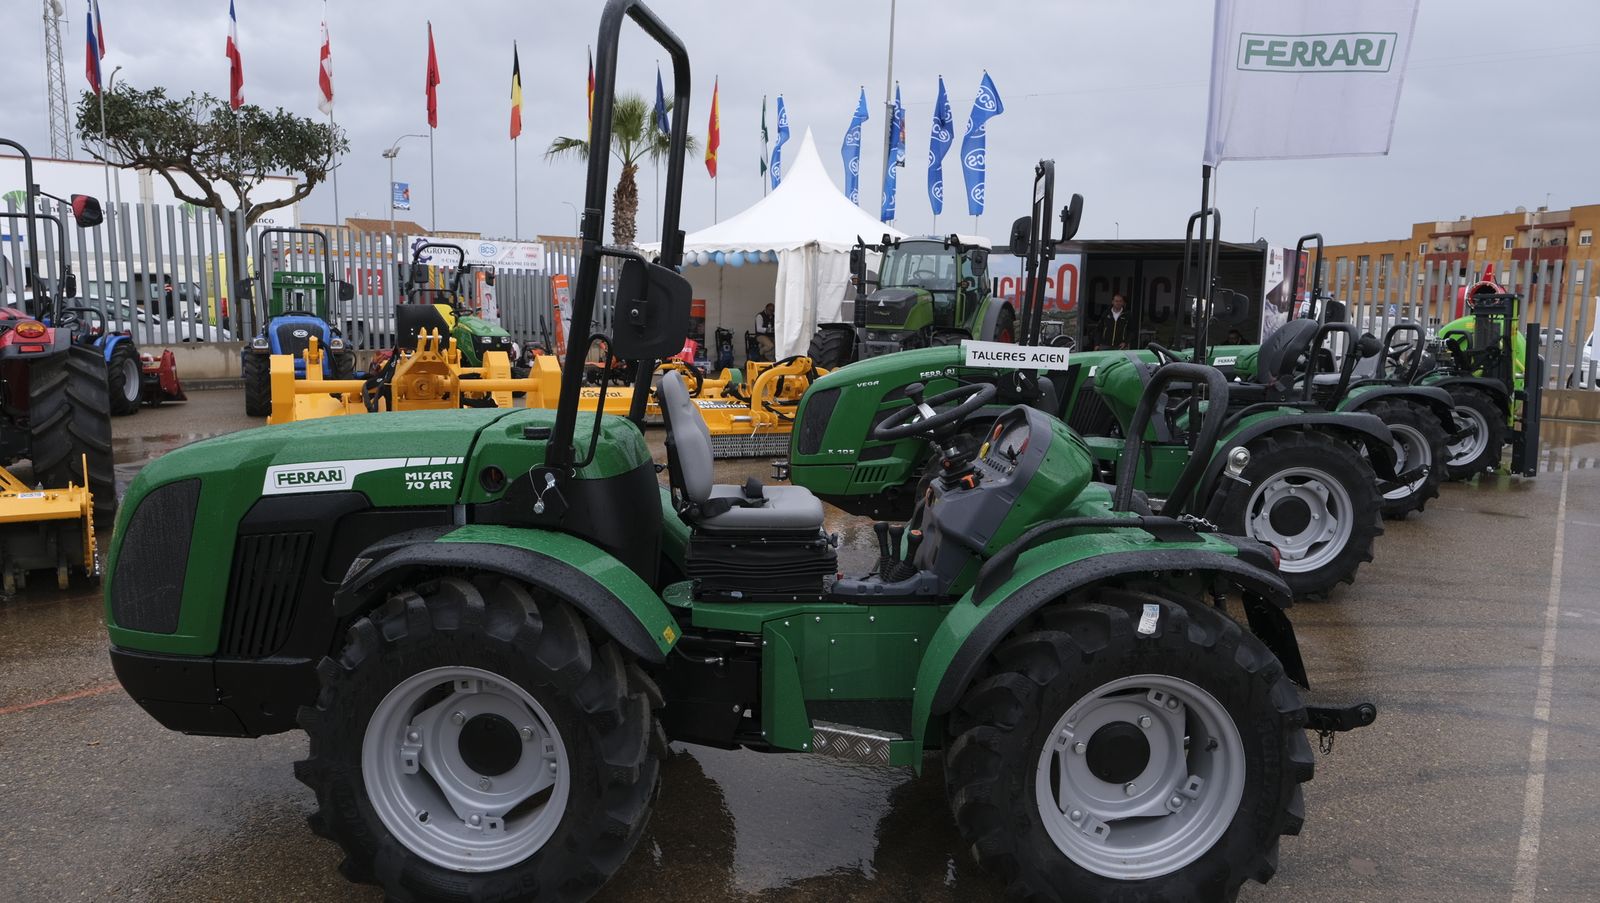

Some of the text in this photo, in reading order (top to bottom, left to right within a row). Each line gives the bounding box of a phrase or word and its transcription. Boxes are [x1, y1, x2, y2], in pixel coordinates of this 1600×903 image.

[1244, 38, 1387, 67] FERRARI
[972, 350, 1065, 363] TALLERES ACIEN
[920, 368, 955, 378] FERRRI
[277, 469, 343, 486] FERRARI
[405, 471, 453, 480] MIZAR
[405, 481, 452, 490] 70 AR
